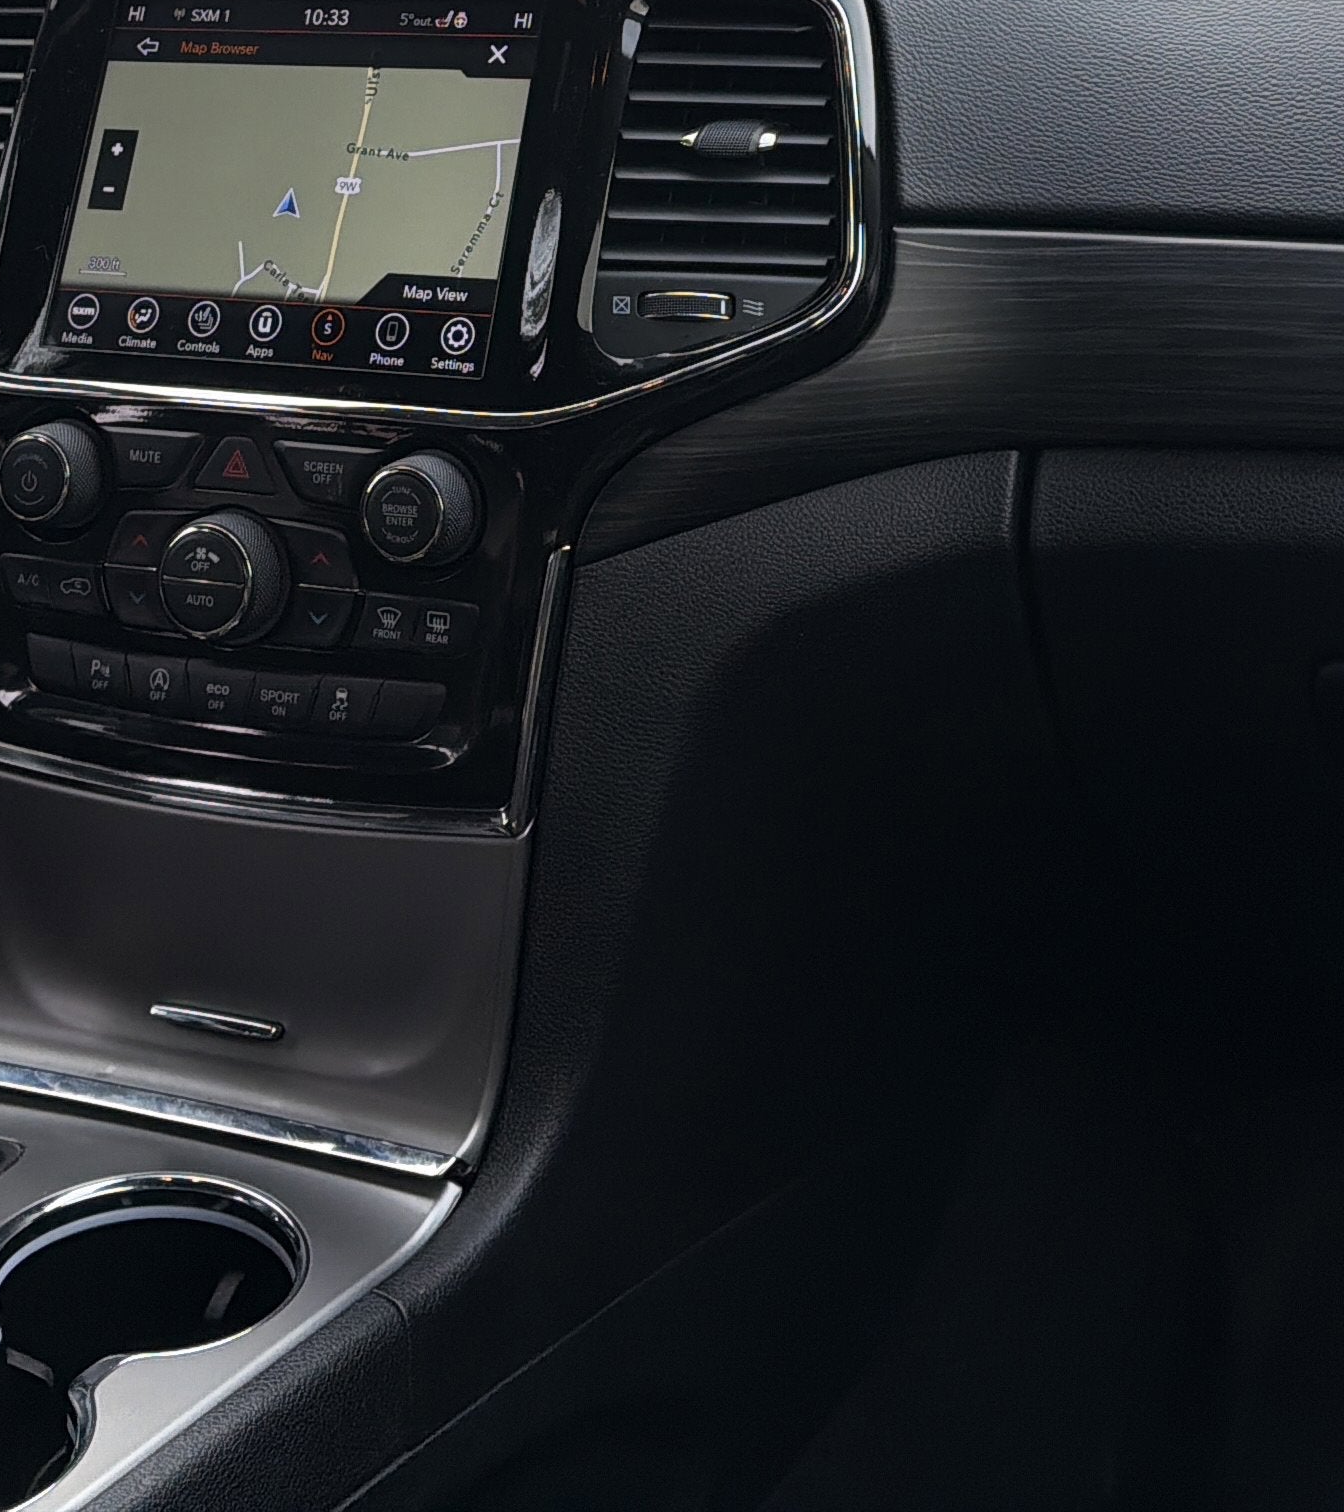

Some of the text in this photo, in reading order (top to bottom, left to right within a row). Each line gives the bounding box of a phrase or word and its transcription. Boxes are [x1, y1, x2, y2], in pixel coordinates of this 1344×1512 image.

[127, 6, 146, 22] HI
[190, 9, 231, 23] SXM 1
[304, 9, 350, 27] 10:33
[513, 13, 533, 29] HI
[180, 41, 260, 56] Map Browser
[346, 142, 410, 162] Grant Ave
[339, 181, 357, 192] 9W
[489, 191, 504, 208] Ct
[88, 256, 109, 270] 300
[403, 285, 468, 302] Map View
[61, 331, 93, 345] Media
[118, 336, 157, 349] Climate
[177, 340, 220, 354] Controls
[245, 344, 274, 358] Apps
[311, 349, 334, 362] Nav
[369, 353, 405, 367] Phone
[430, 357, 475, 374] Settings
[129, 449, 162, 464] MUTE
[304, 461, 344, 475] SCREEN
[312, 473, 333, 485] OFF
[382, 503, 418, 515] BROWSE
[386, 516, 413, 527] ENTER
[191, 561, 210, 572] OFF
[17, 573, 39, 587] A/C
[185, 593, 214, 607] AUTO
[372, 628, 401, 640] FRONT
[425, 633, 449, 645] REAR
[92, 679, 109, 690] OFF
[206, 683, 230, 696] eco
[149, 690, 166, 701] OFF
[260, 689, 300, 705] SPORT
[208, 699, 225, 710] OFF
[271, 705, 287, 717] ON
[329, 710, 348, 721] OFF
